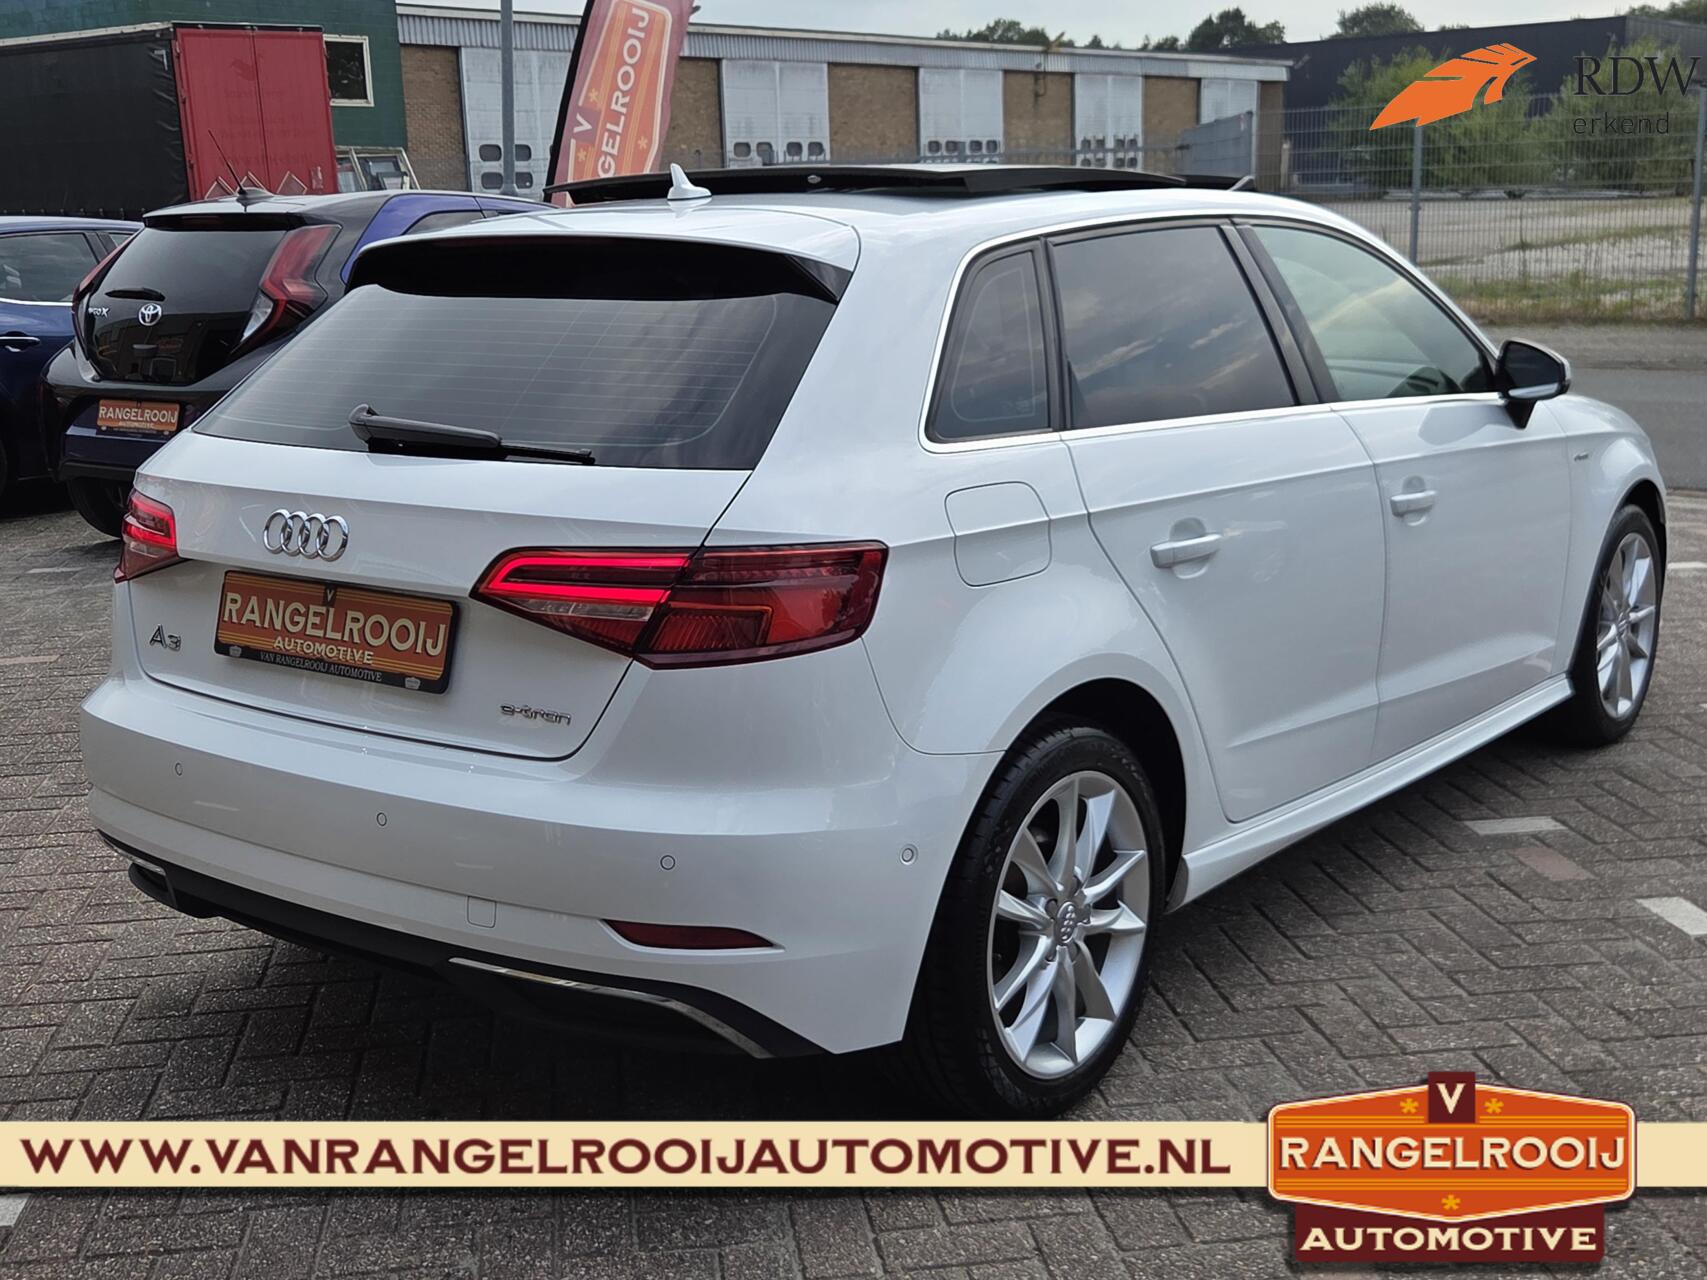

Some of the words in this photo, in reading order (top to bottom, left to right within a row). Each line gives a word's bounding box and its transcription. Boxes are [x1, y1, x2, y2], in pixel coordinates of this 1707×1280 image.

[573, 112, 593, 134] V
[98, 406, 178, 423] RANGELROOIJ
[326, 588, 335, 602] V
[222, 592, 447, 657] RANGELROOIJ
[149, 624, 181, 652] A3
[272, 635, 376, 665] AUTOMOTIVE
[259, 651, 276, 663] VAN
[276, 655, 328, 674] RANGELROOIJ
[328, 664, 383, 683] AUTOMOTIVE
[500, 703, 571, 726] e-tron
